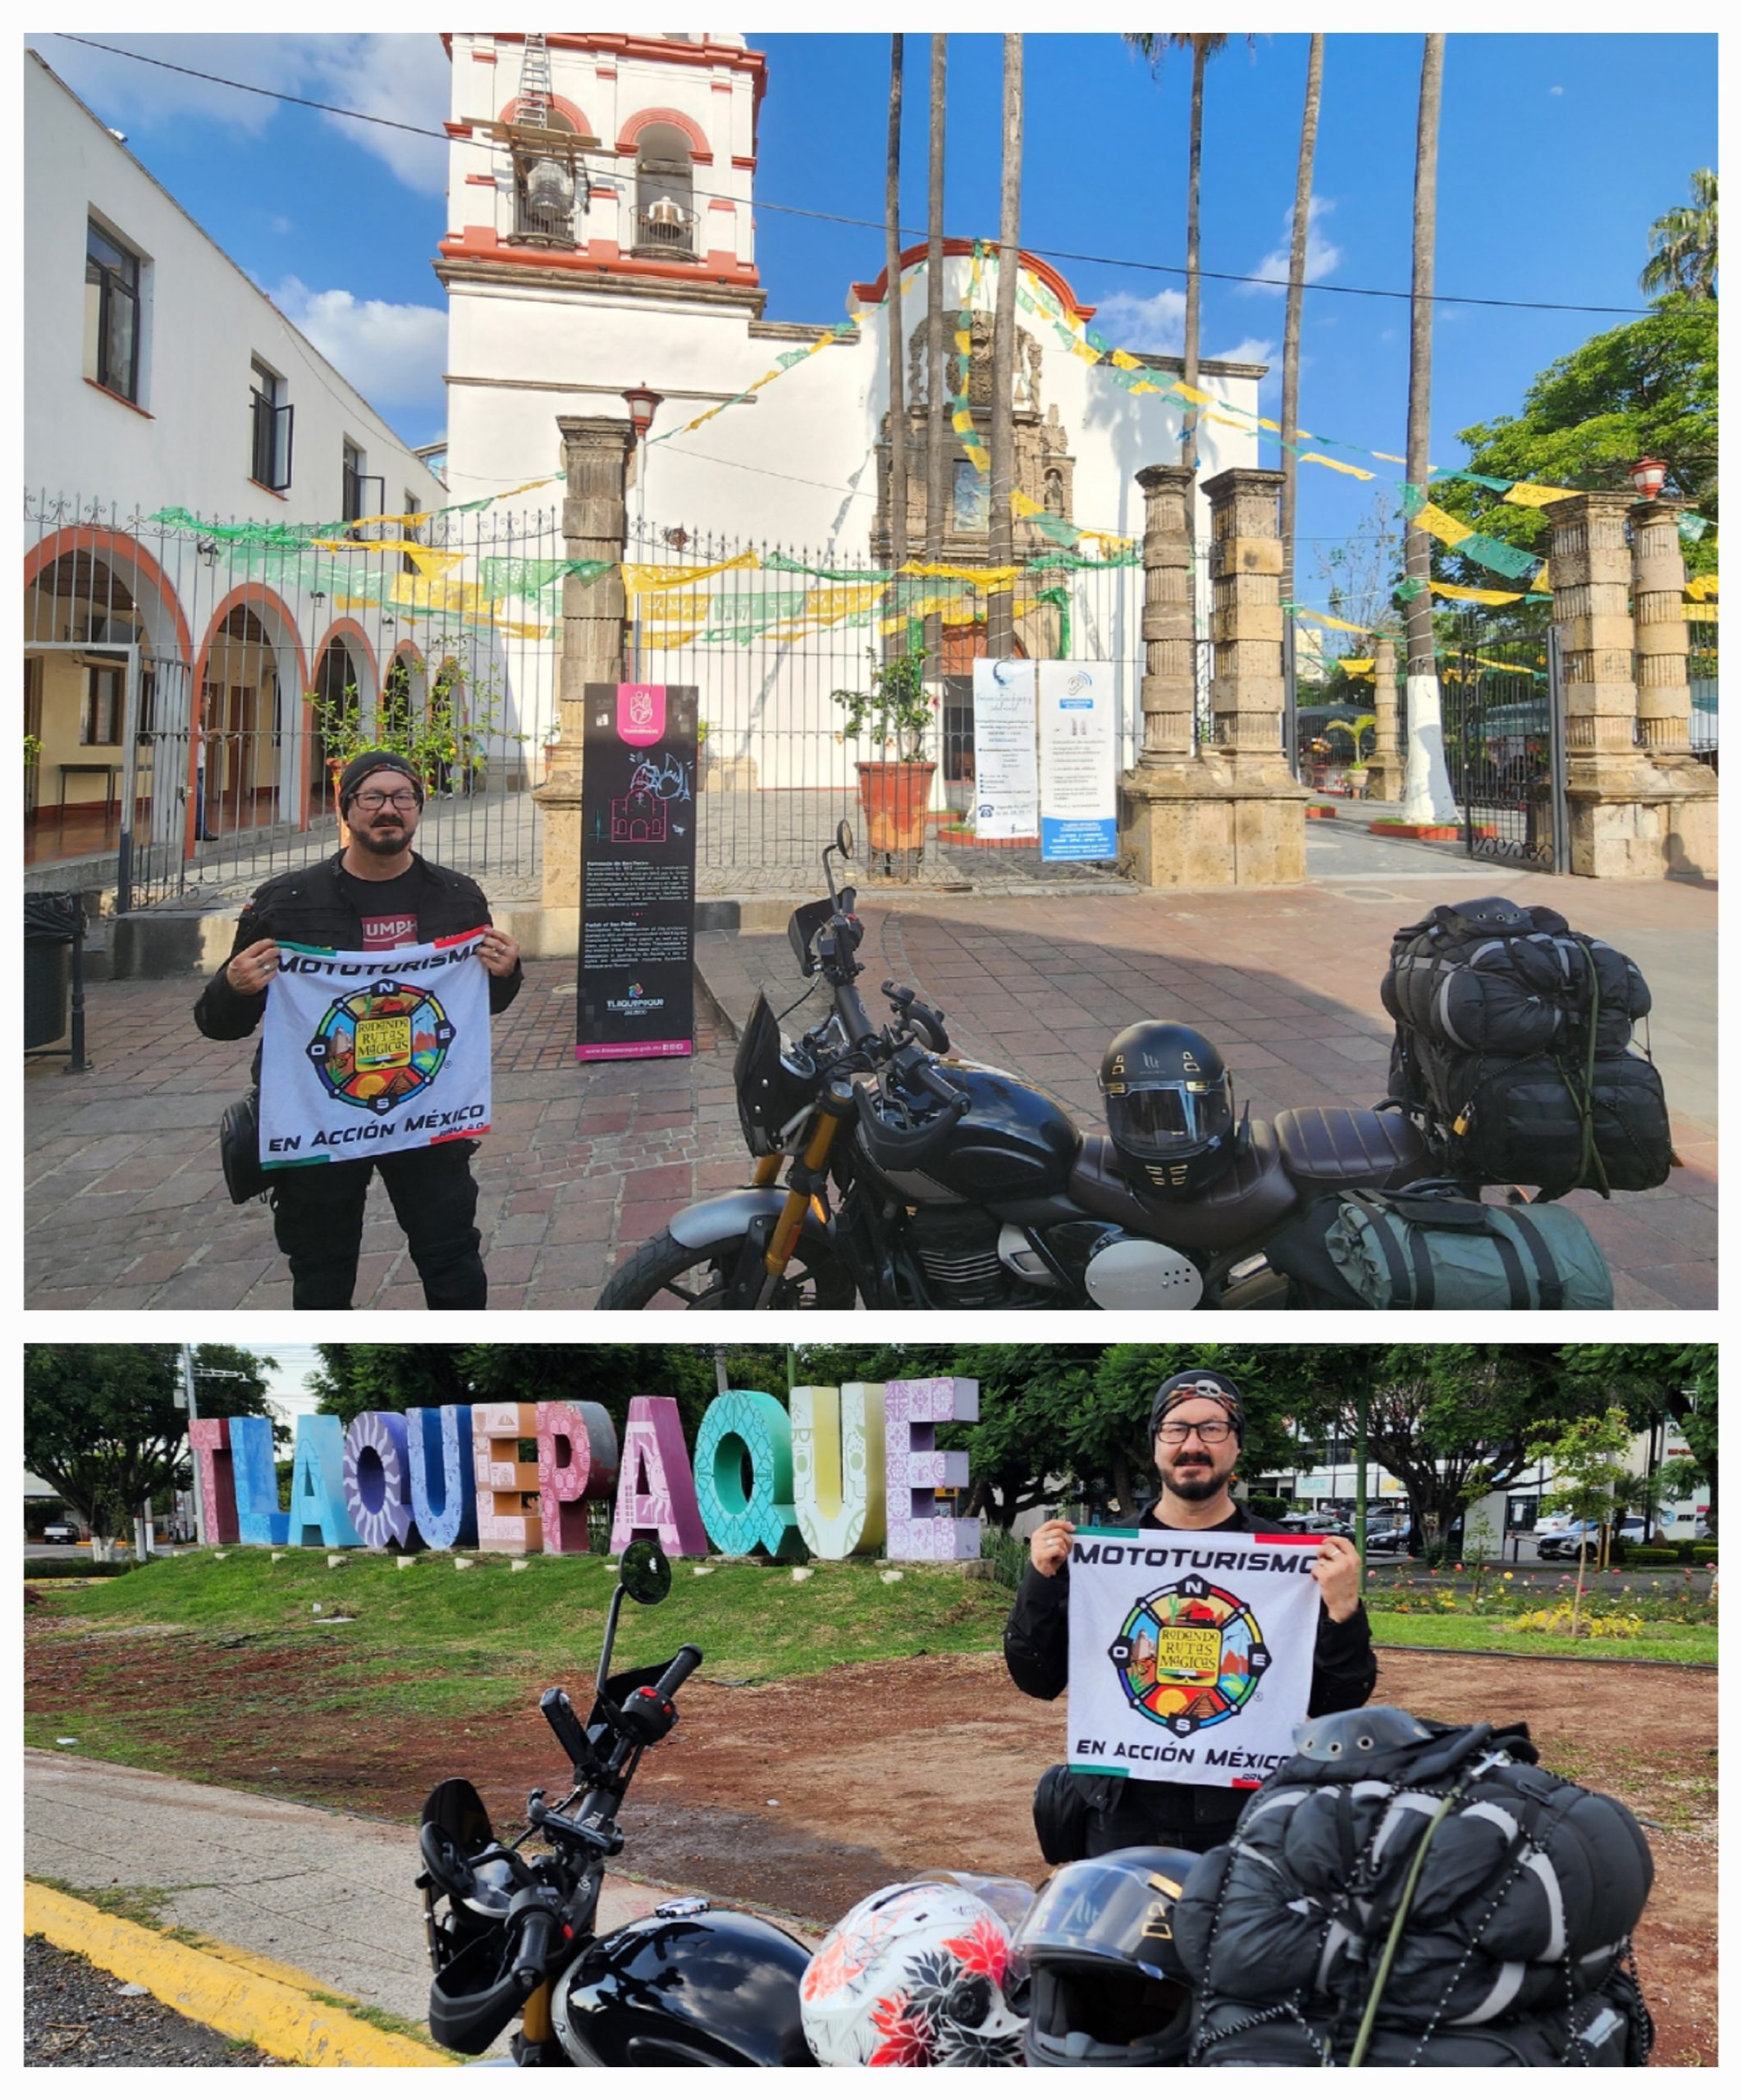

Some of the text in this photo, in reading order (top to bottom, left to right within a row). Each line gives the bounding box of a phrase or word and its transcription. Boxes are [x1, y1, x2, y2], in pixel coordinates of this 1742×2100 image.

[378, 983, 395, 993] N
[440, 1029, 450, 1039] E
[377, 1098, 390, 1108] S
[269, 1104, 484, 1153] EN ACCIÓN MÉXICO
[189, 1377, 981, 1559] TLAQUEPAQUE
[1186, 1582, 1203, 1594] N
[1252, 1654, 1265, 1666] E
[1176, 1719, 1191, 1731] S
[1076, 1739, 1106, 1755] EN
[1113, 1742, 1196, 1764] ACCIÓN
